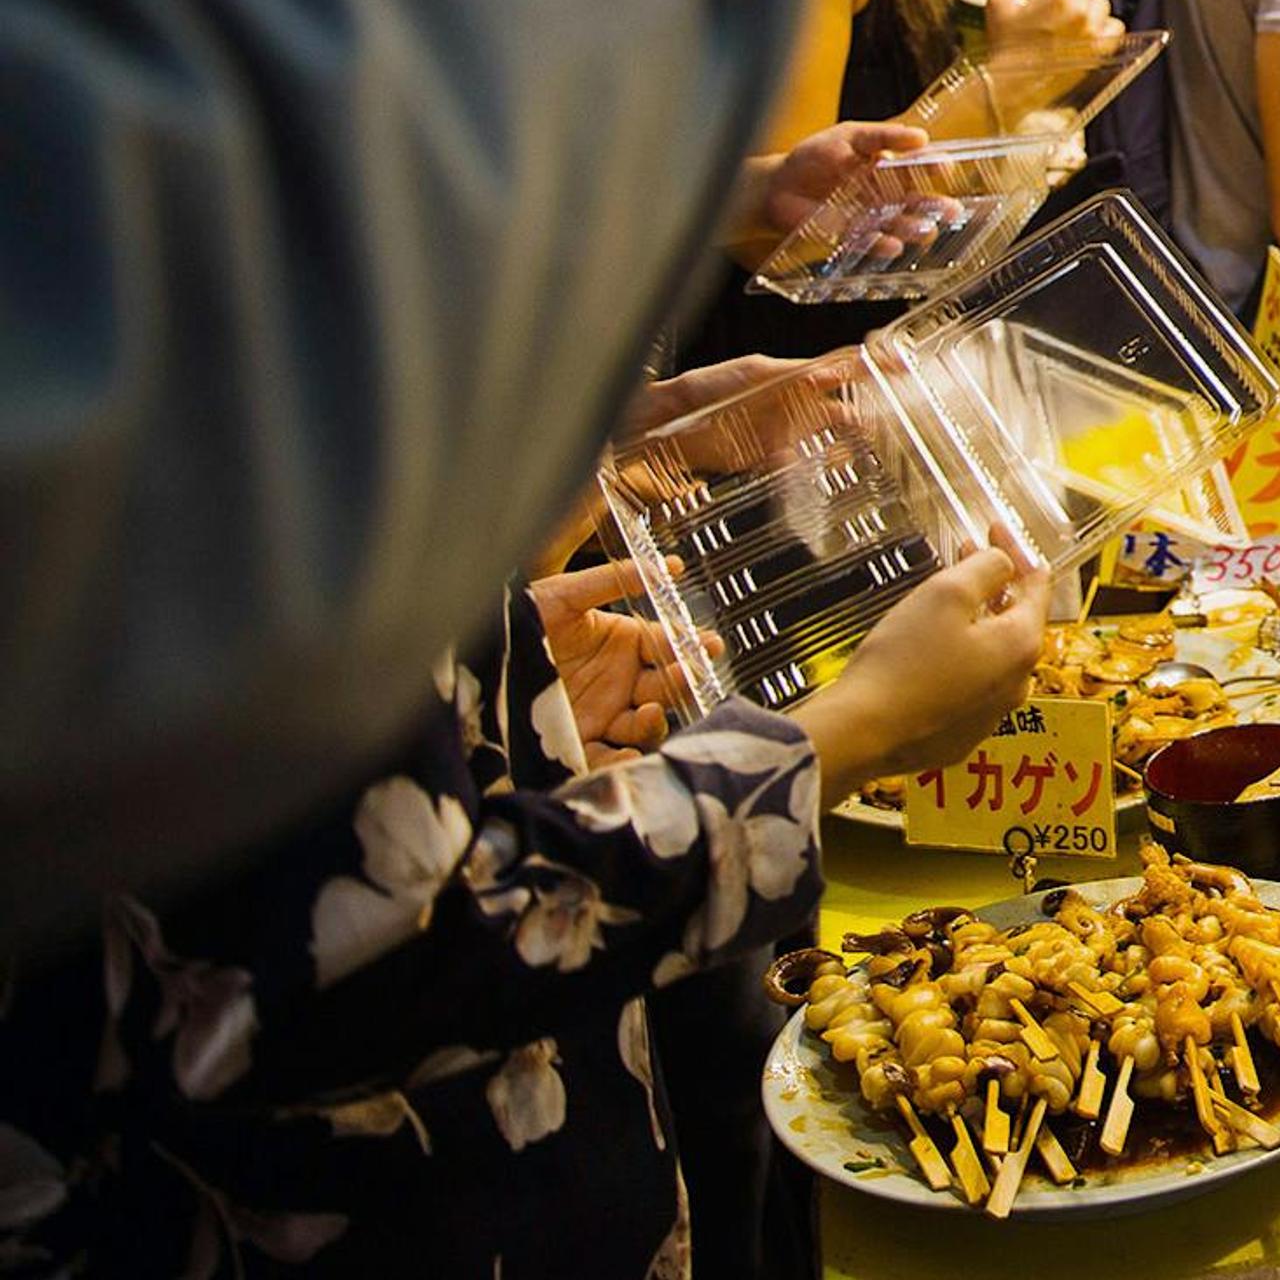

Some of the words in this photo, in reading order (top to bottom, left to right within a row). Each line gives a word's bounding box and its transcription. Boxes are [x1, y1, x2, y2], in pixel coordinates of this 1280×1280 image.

[916, 749, 1103, 817] イカゲソ
[1033, 822, 1108, 852] ¥250
